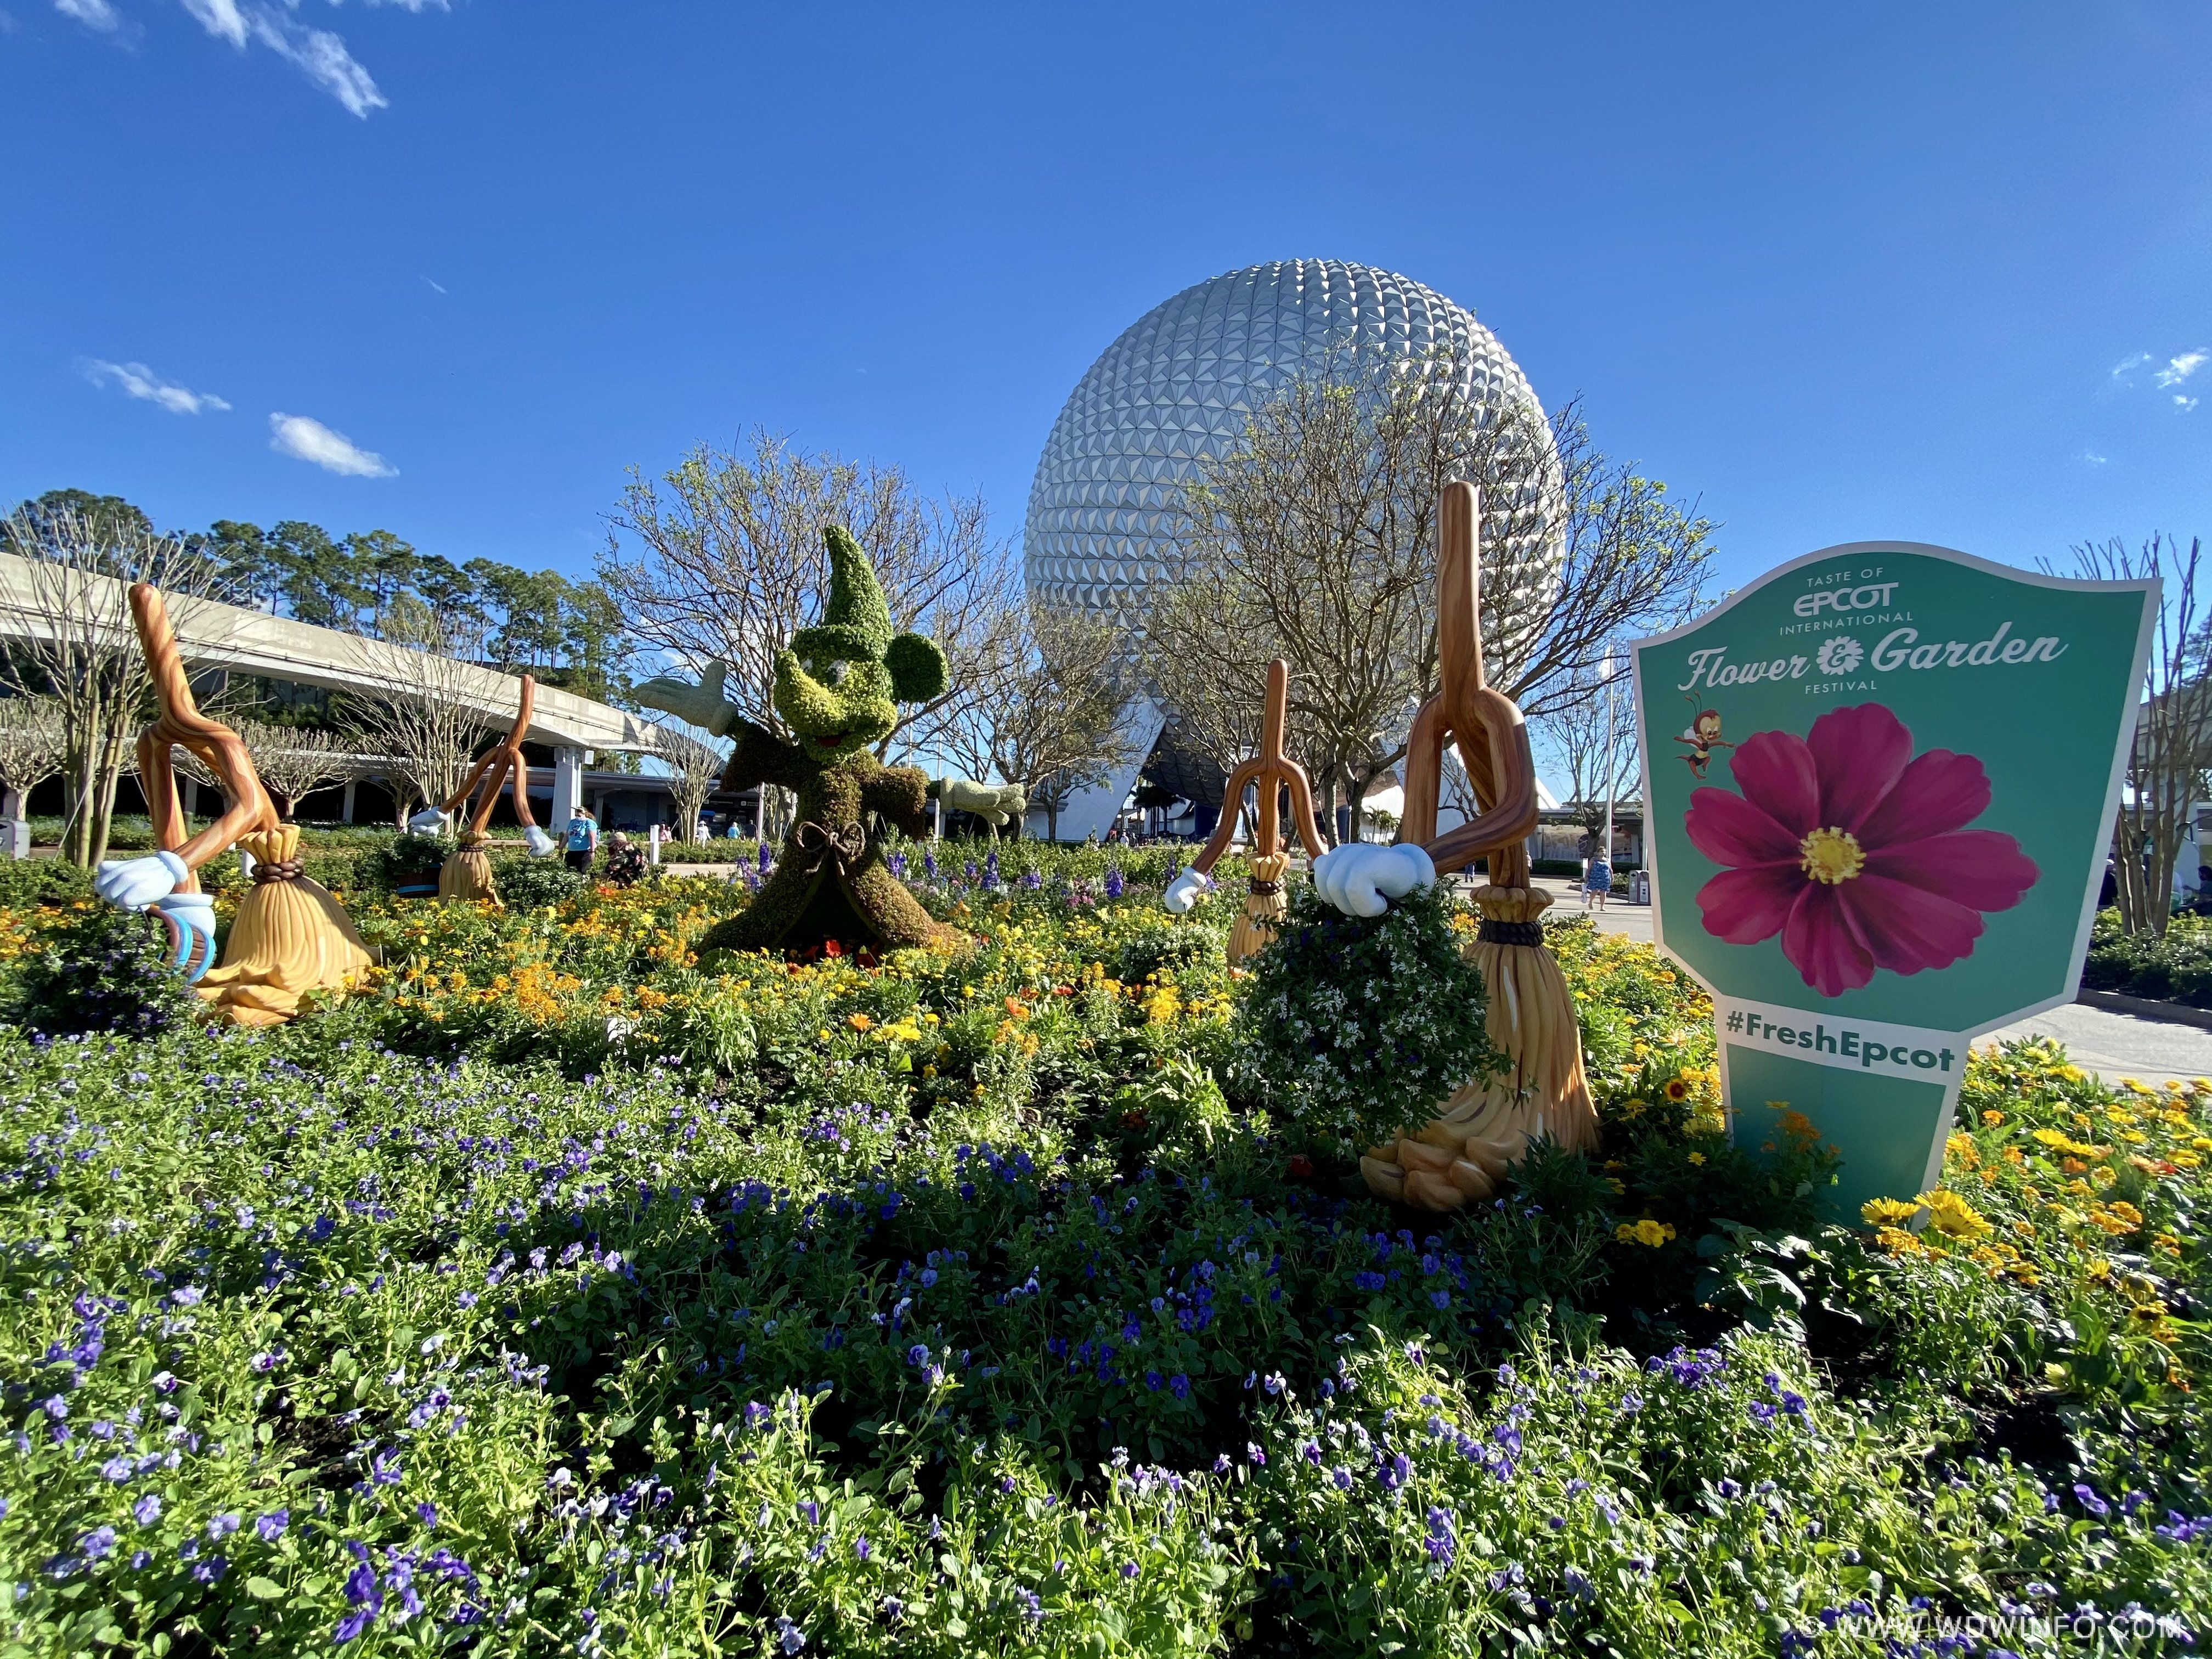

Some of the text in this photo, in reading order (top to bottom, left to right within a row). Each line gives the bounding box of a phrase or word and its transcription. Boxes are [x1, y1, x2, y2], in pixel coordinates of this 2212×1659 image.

[1807, 567, 1883, 588] TASTE OF
[1793, 582, 1899, 617] EPCOT
[1780, 611, 1914, 636] INTERNATIONAL
[1677, 646, 1811, 691] Flower
[1870, 621, 2069, 672] Garden
[1805, 680, 1877, 695] FESTIVAL
[1726, 1010, 1955, 1071] #FreshEpcot
